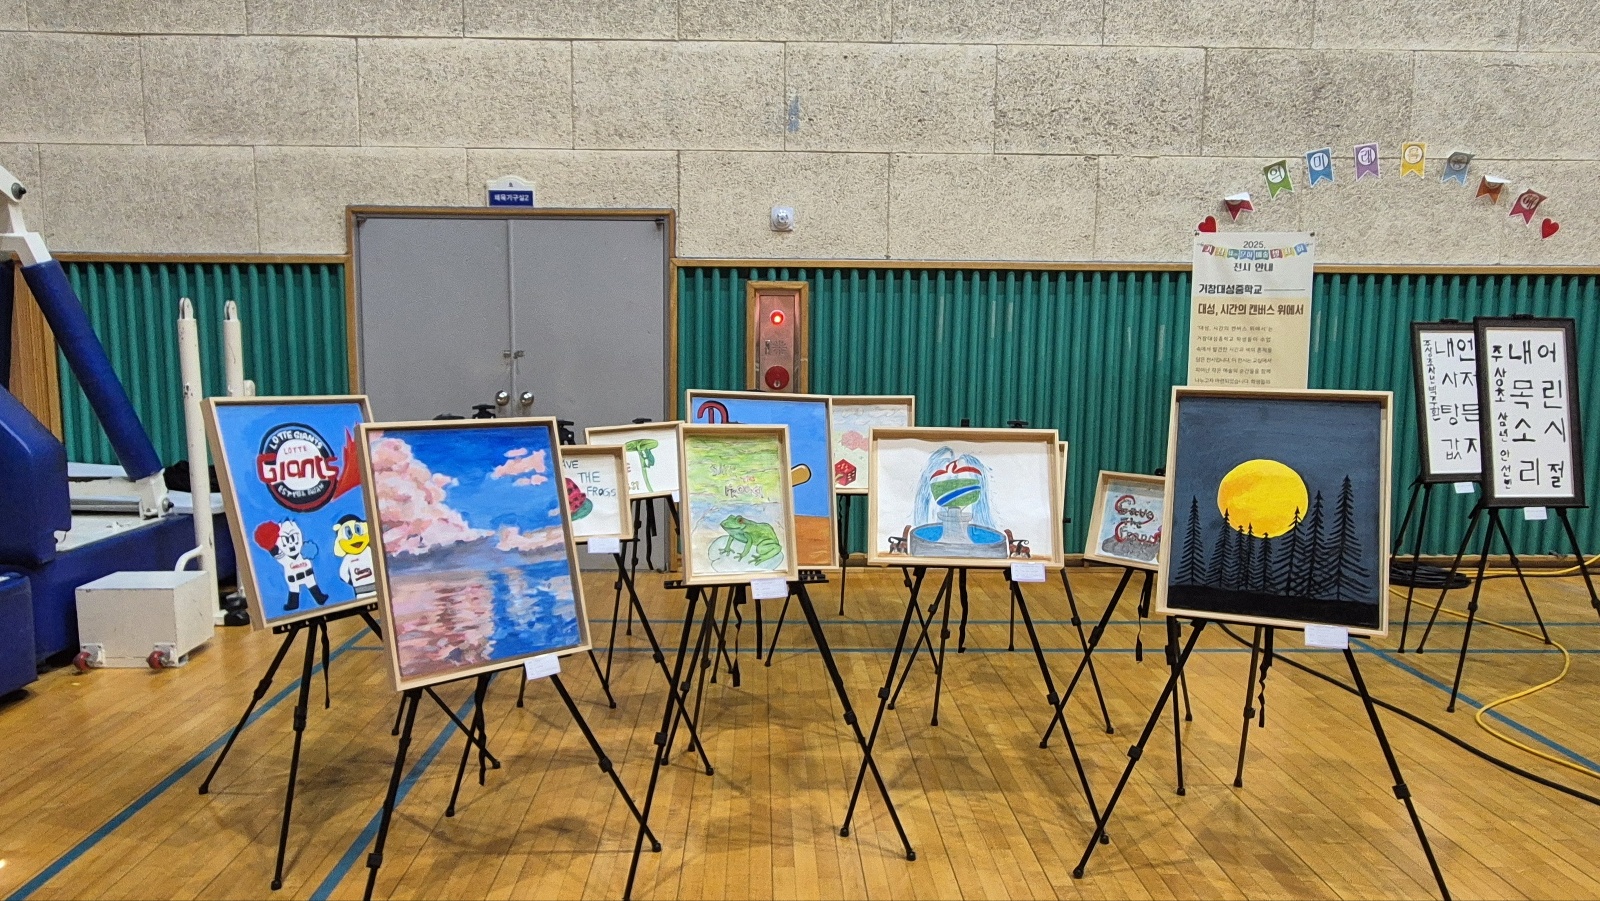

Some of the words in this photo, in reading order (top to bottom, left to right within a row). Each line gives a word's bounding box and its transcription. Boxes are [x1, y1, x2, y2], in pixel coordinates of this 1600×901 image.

[1243, 241, 1266, 249] 2025.
[1234, 262, 1251, 272] 전시
[1255, 262, 1274, 272] 안내
[1199, 284, 1263, 294] 거창대성중학교
[1198, 303, 1218, 316] 대성,
[1220, 303, 1246, 315] 시간의
[1248, 303, 1275, 315] 캔버스
[1277, 304, 1304, 315] 위에서
[293, 430, 323, 448] GIANTS
[256, 452, 339, 484] Giants
[577, 471, 601, 484] THE
[586, 486, 617, 498] FROGS
